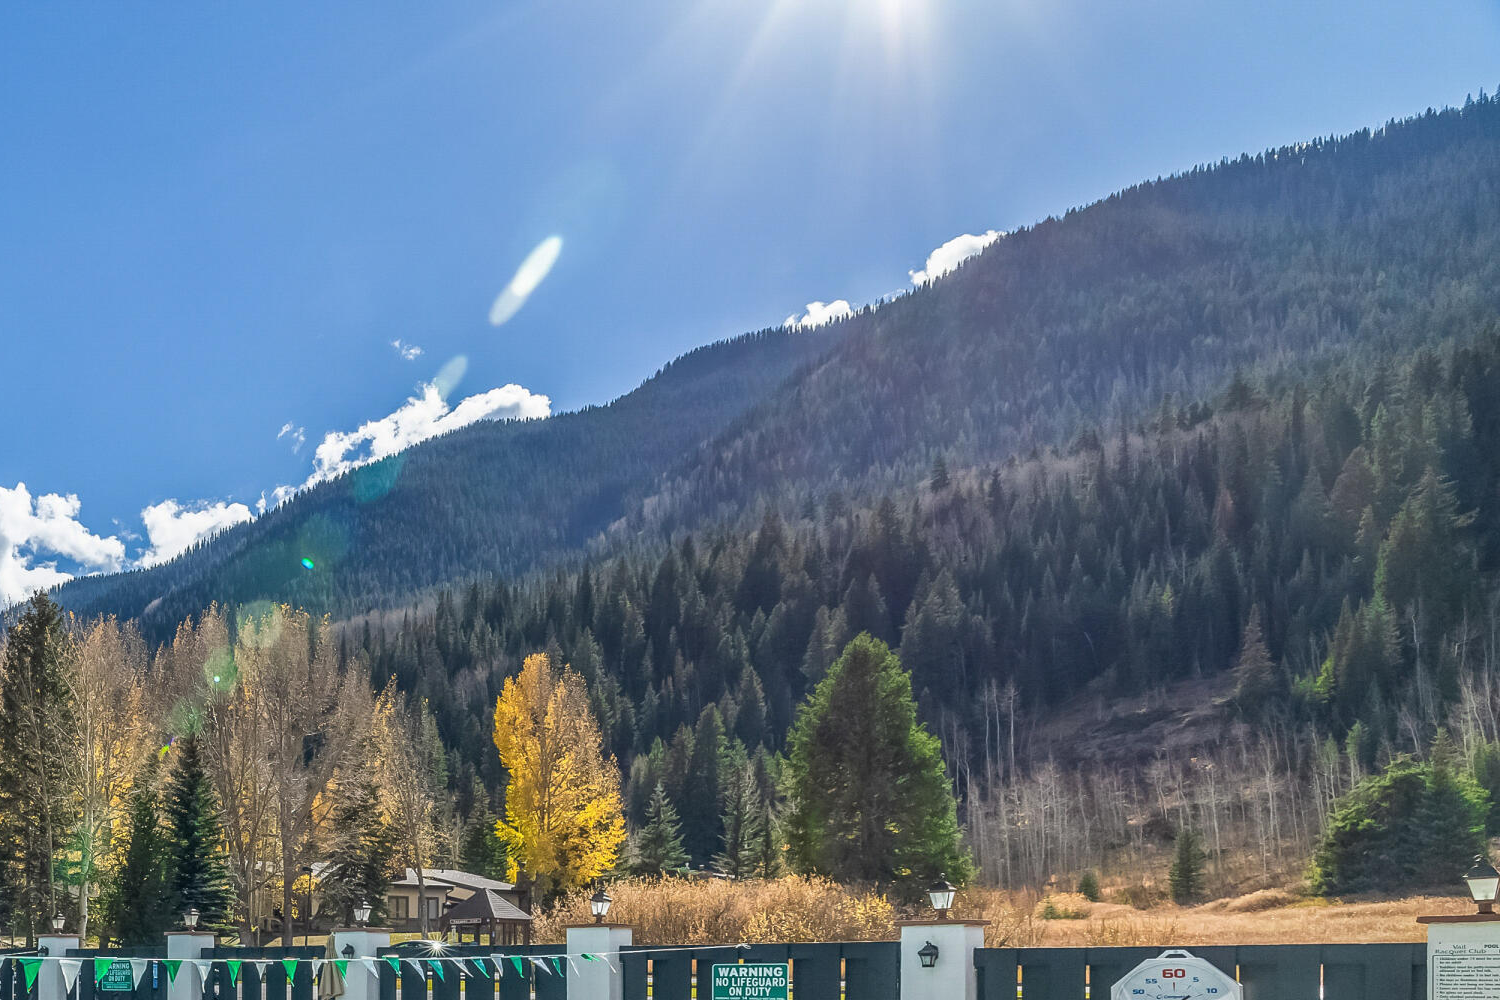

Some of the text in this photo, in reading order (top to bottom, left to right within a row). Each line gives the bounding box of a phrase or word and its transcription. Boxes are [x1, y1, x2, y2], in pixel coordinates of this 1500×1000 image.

[108, 962, 130, 970] ARNING
[717, 967, 783, 977] WARNING
[1162, 968, 1186, 979] 60
[715, 977, 786, 987] NO LIFEGUARD
[728, 986, 772, 997] ON DUTY
